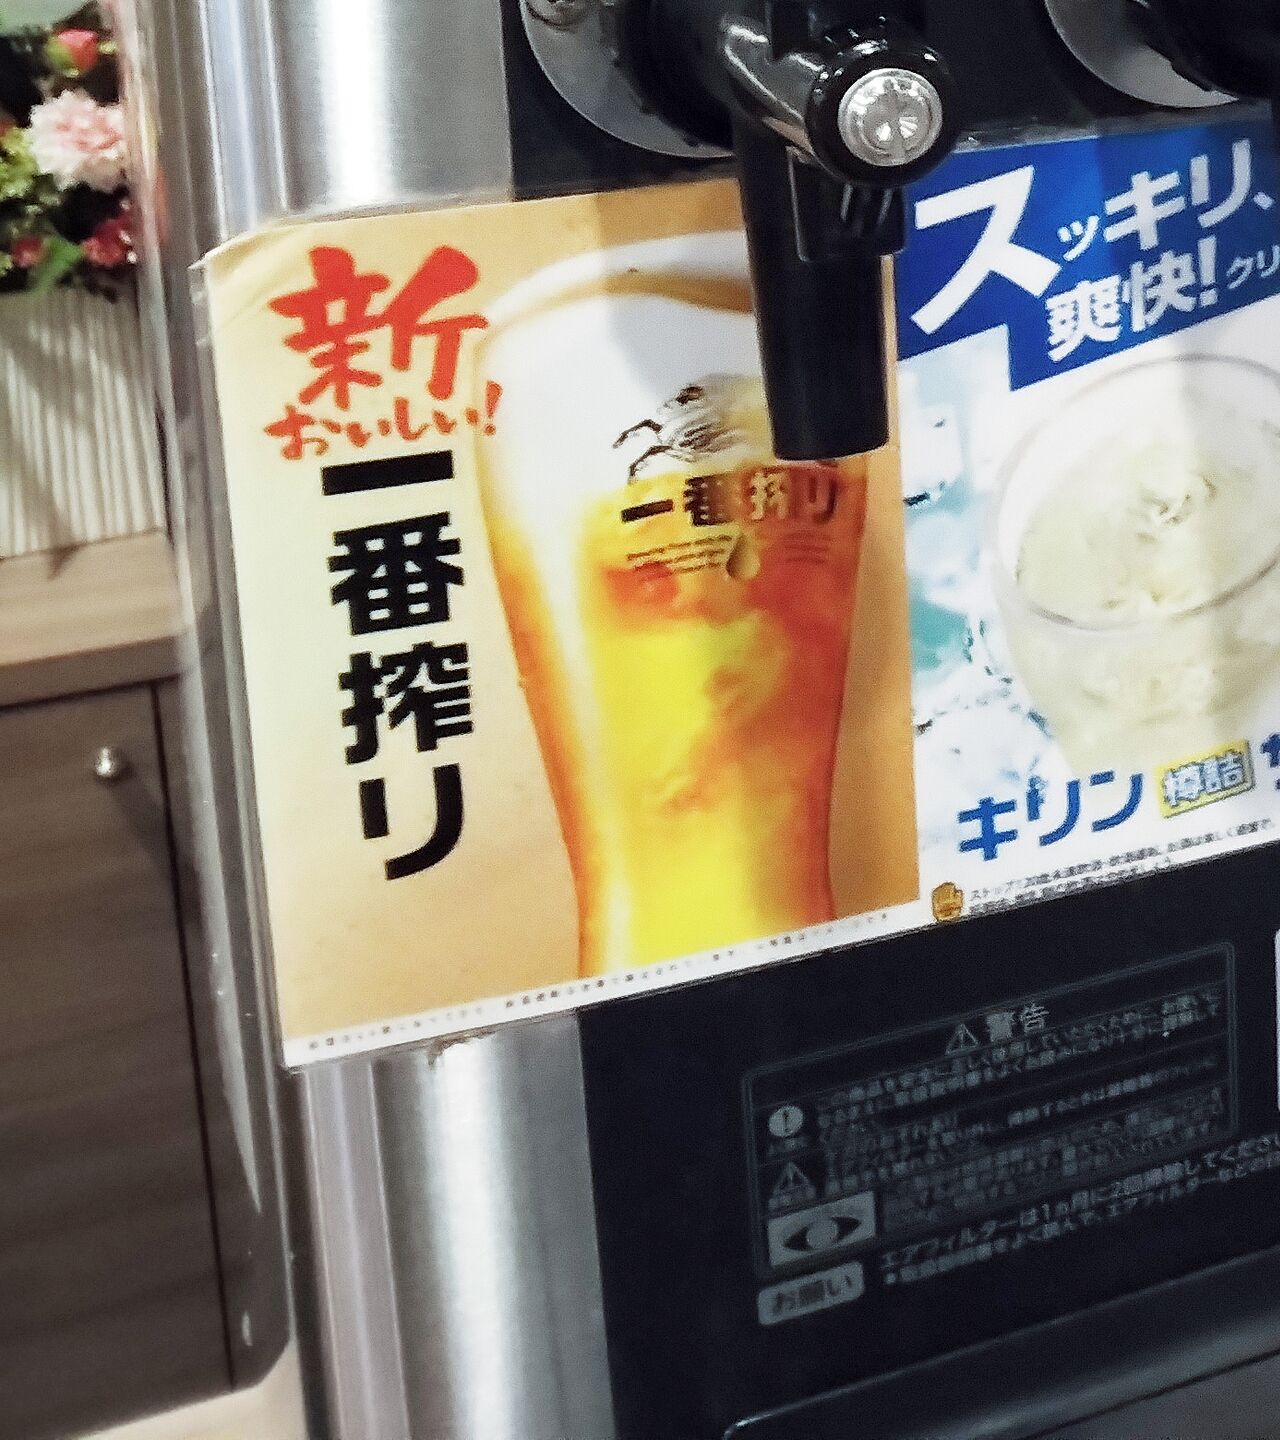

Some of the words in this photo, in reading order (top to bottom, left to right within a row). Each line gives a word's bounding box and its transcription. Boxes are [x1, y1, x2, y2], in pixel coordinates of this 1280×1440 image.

[267, 245, 488, 410] 新
[620, 470, 838, 527] 一番搾り
[321, 449, 474, 881] 一番搾り
[958, 771, 1144, 861] キリン
